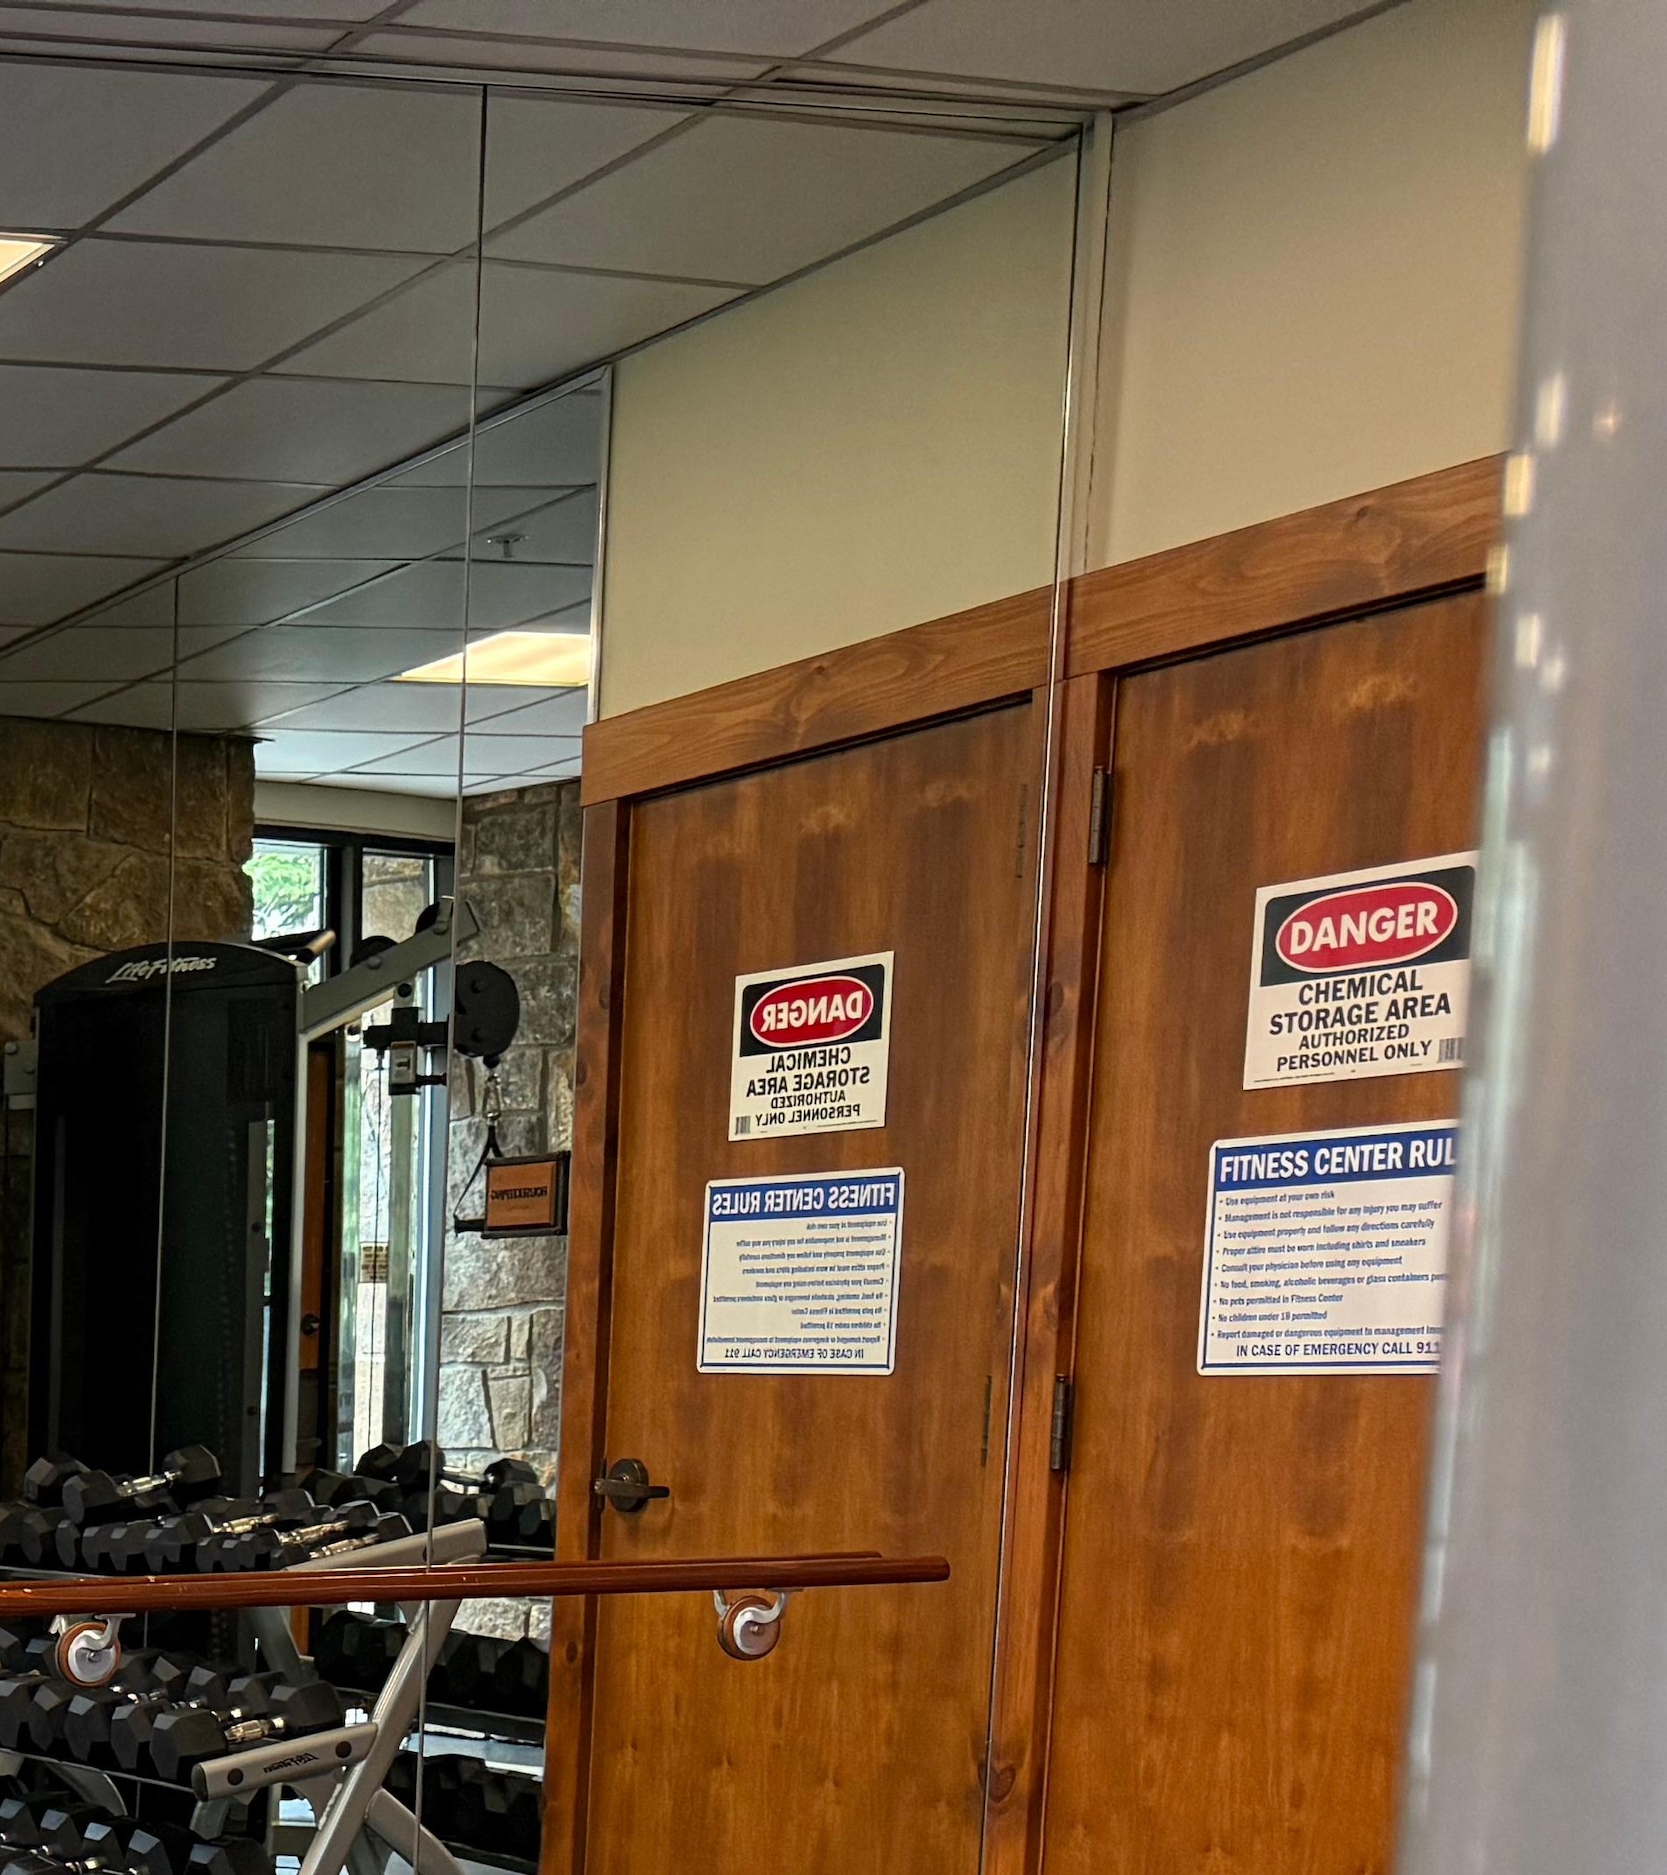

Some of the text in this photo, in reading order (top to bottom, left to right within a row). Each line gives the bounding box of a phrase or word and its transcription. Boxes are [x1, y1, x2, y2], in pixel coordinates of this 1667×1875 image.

[1290, 901, 1438, 955] DANGER
[1299, 969, 1423, 1005] CHEMICAL
[1269, 993, 1451, 1035] STORAGE AREA
[1299, 1024, 1409, 1050] AUTHORIZED
[1277, 1040, 1432, 1071] PERSONNEL ONLY
[1220, 1137, 1455, 1182] FITNESS CENTER RUL
[1237, 1341, 1440, 1357] IN CASE OF EMERGENCY CALL 911
